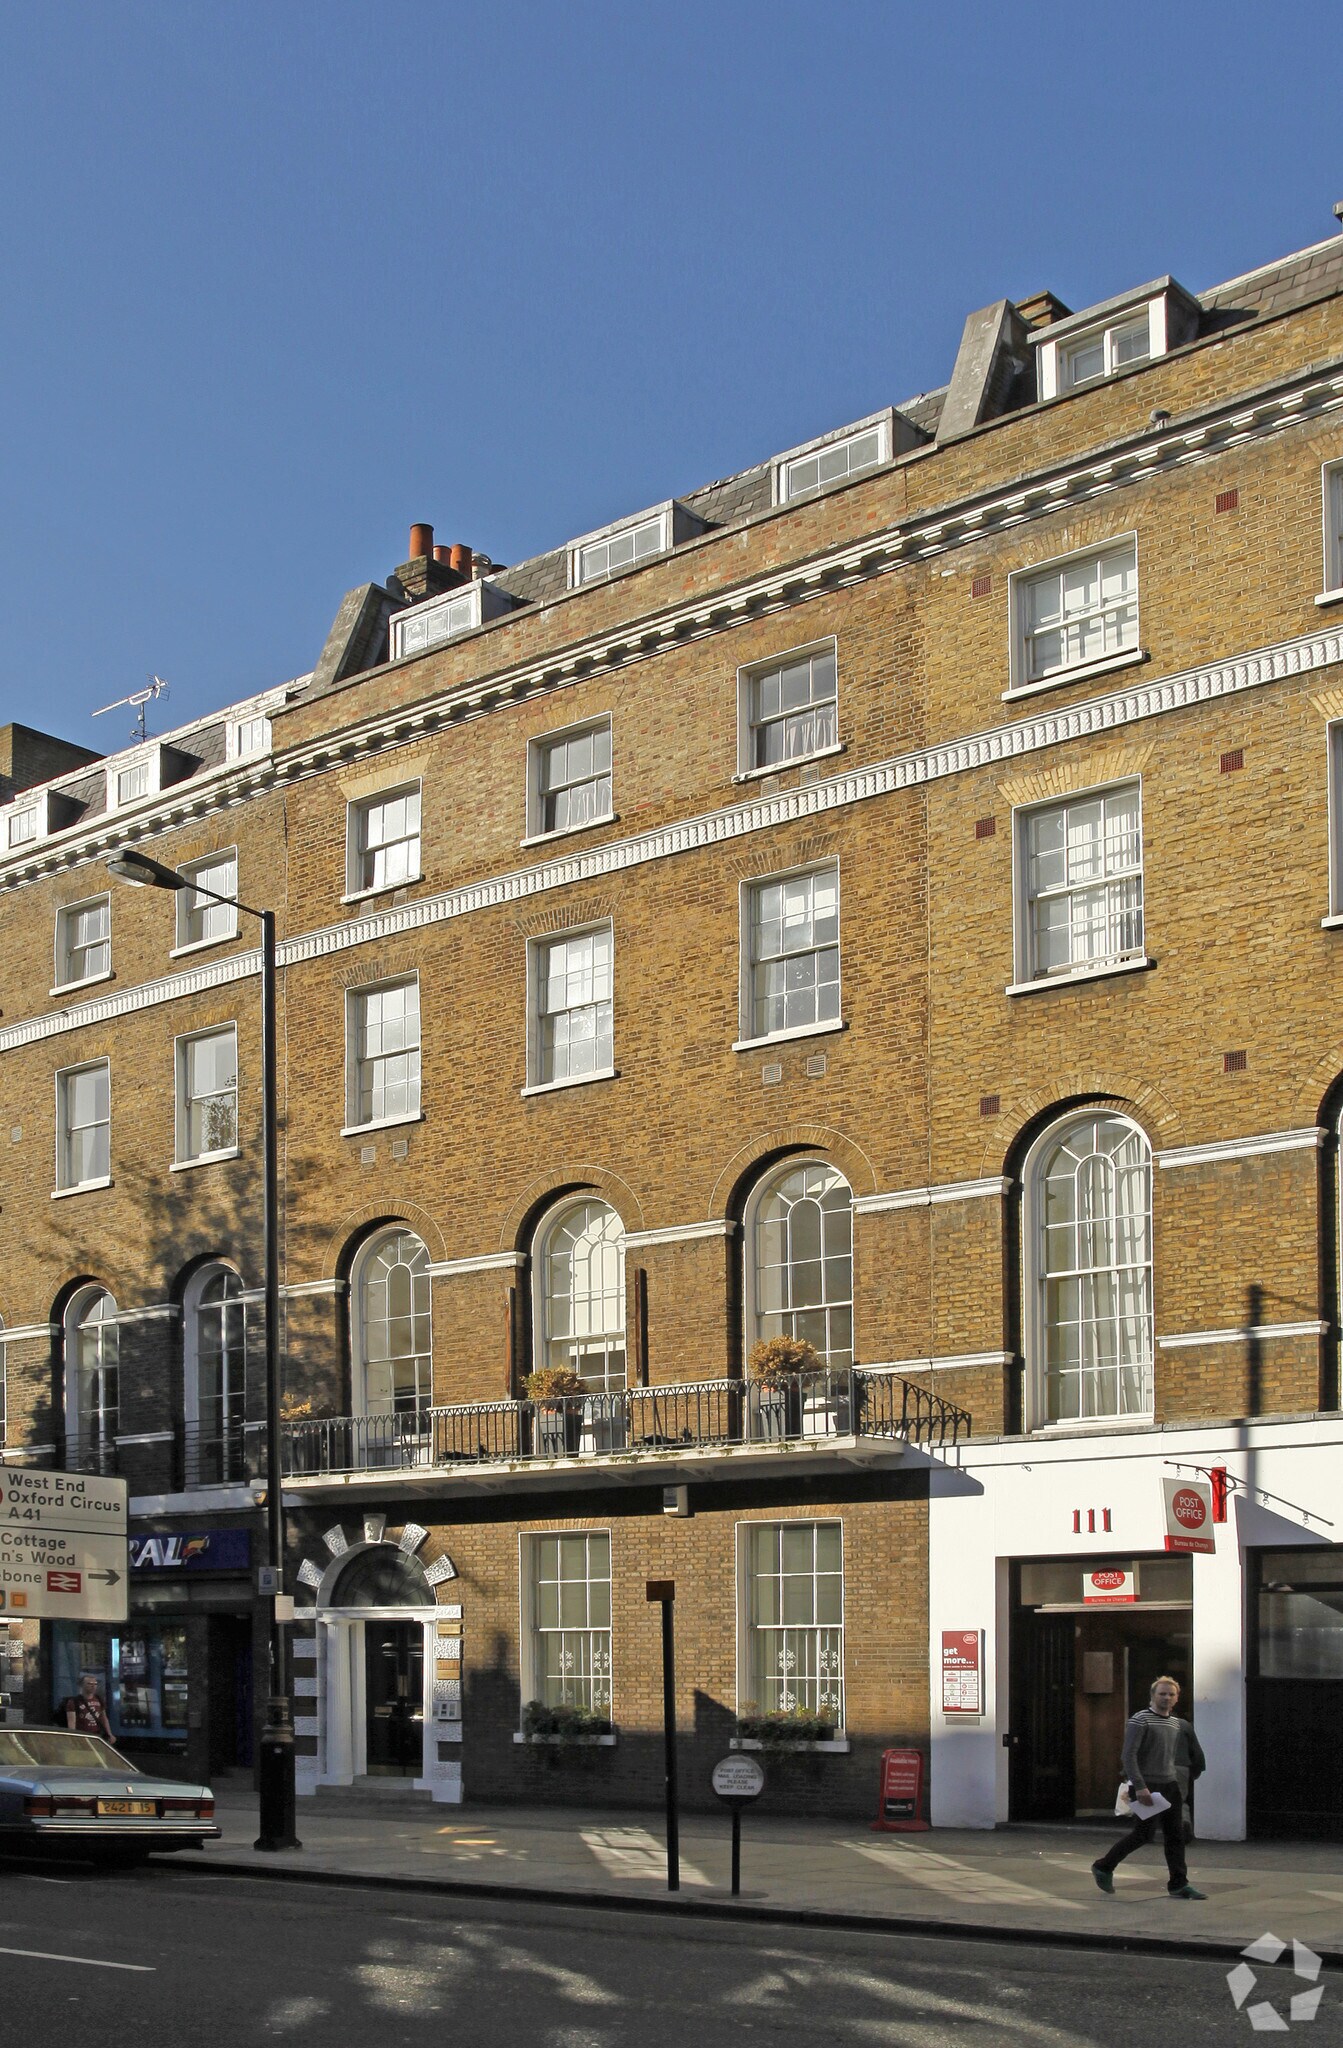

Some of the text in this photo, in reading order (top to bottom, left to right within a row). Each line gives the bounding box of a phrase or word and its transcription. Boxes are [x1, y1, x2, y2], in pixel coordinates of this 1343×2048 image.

[8, 1473, 85, 1493] West End
[8, 1490, 121, 1512] Oxford Circus
[1179, 1496, 1199, 1508] POST
[1072, 1507, 1113, 1533] 111
[1175, 1507, 1203, 1520] OFFICE
[1, 1533, 67, 1550] Cottage
[31, 1551, 76, 1566] Wood
[0, 1569, 42, 1583] bone
[1094, 1577, 1122, 1586] OFFICE
[943, 1648, 958, 1656] get
